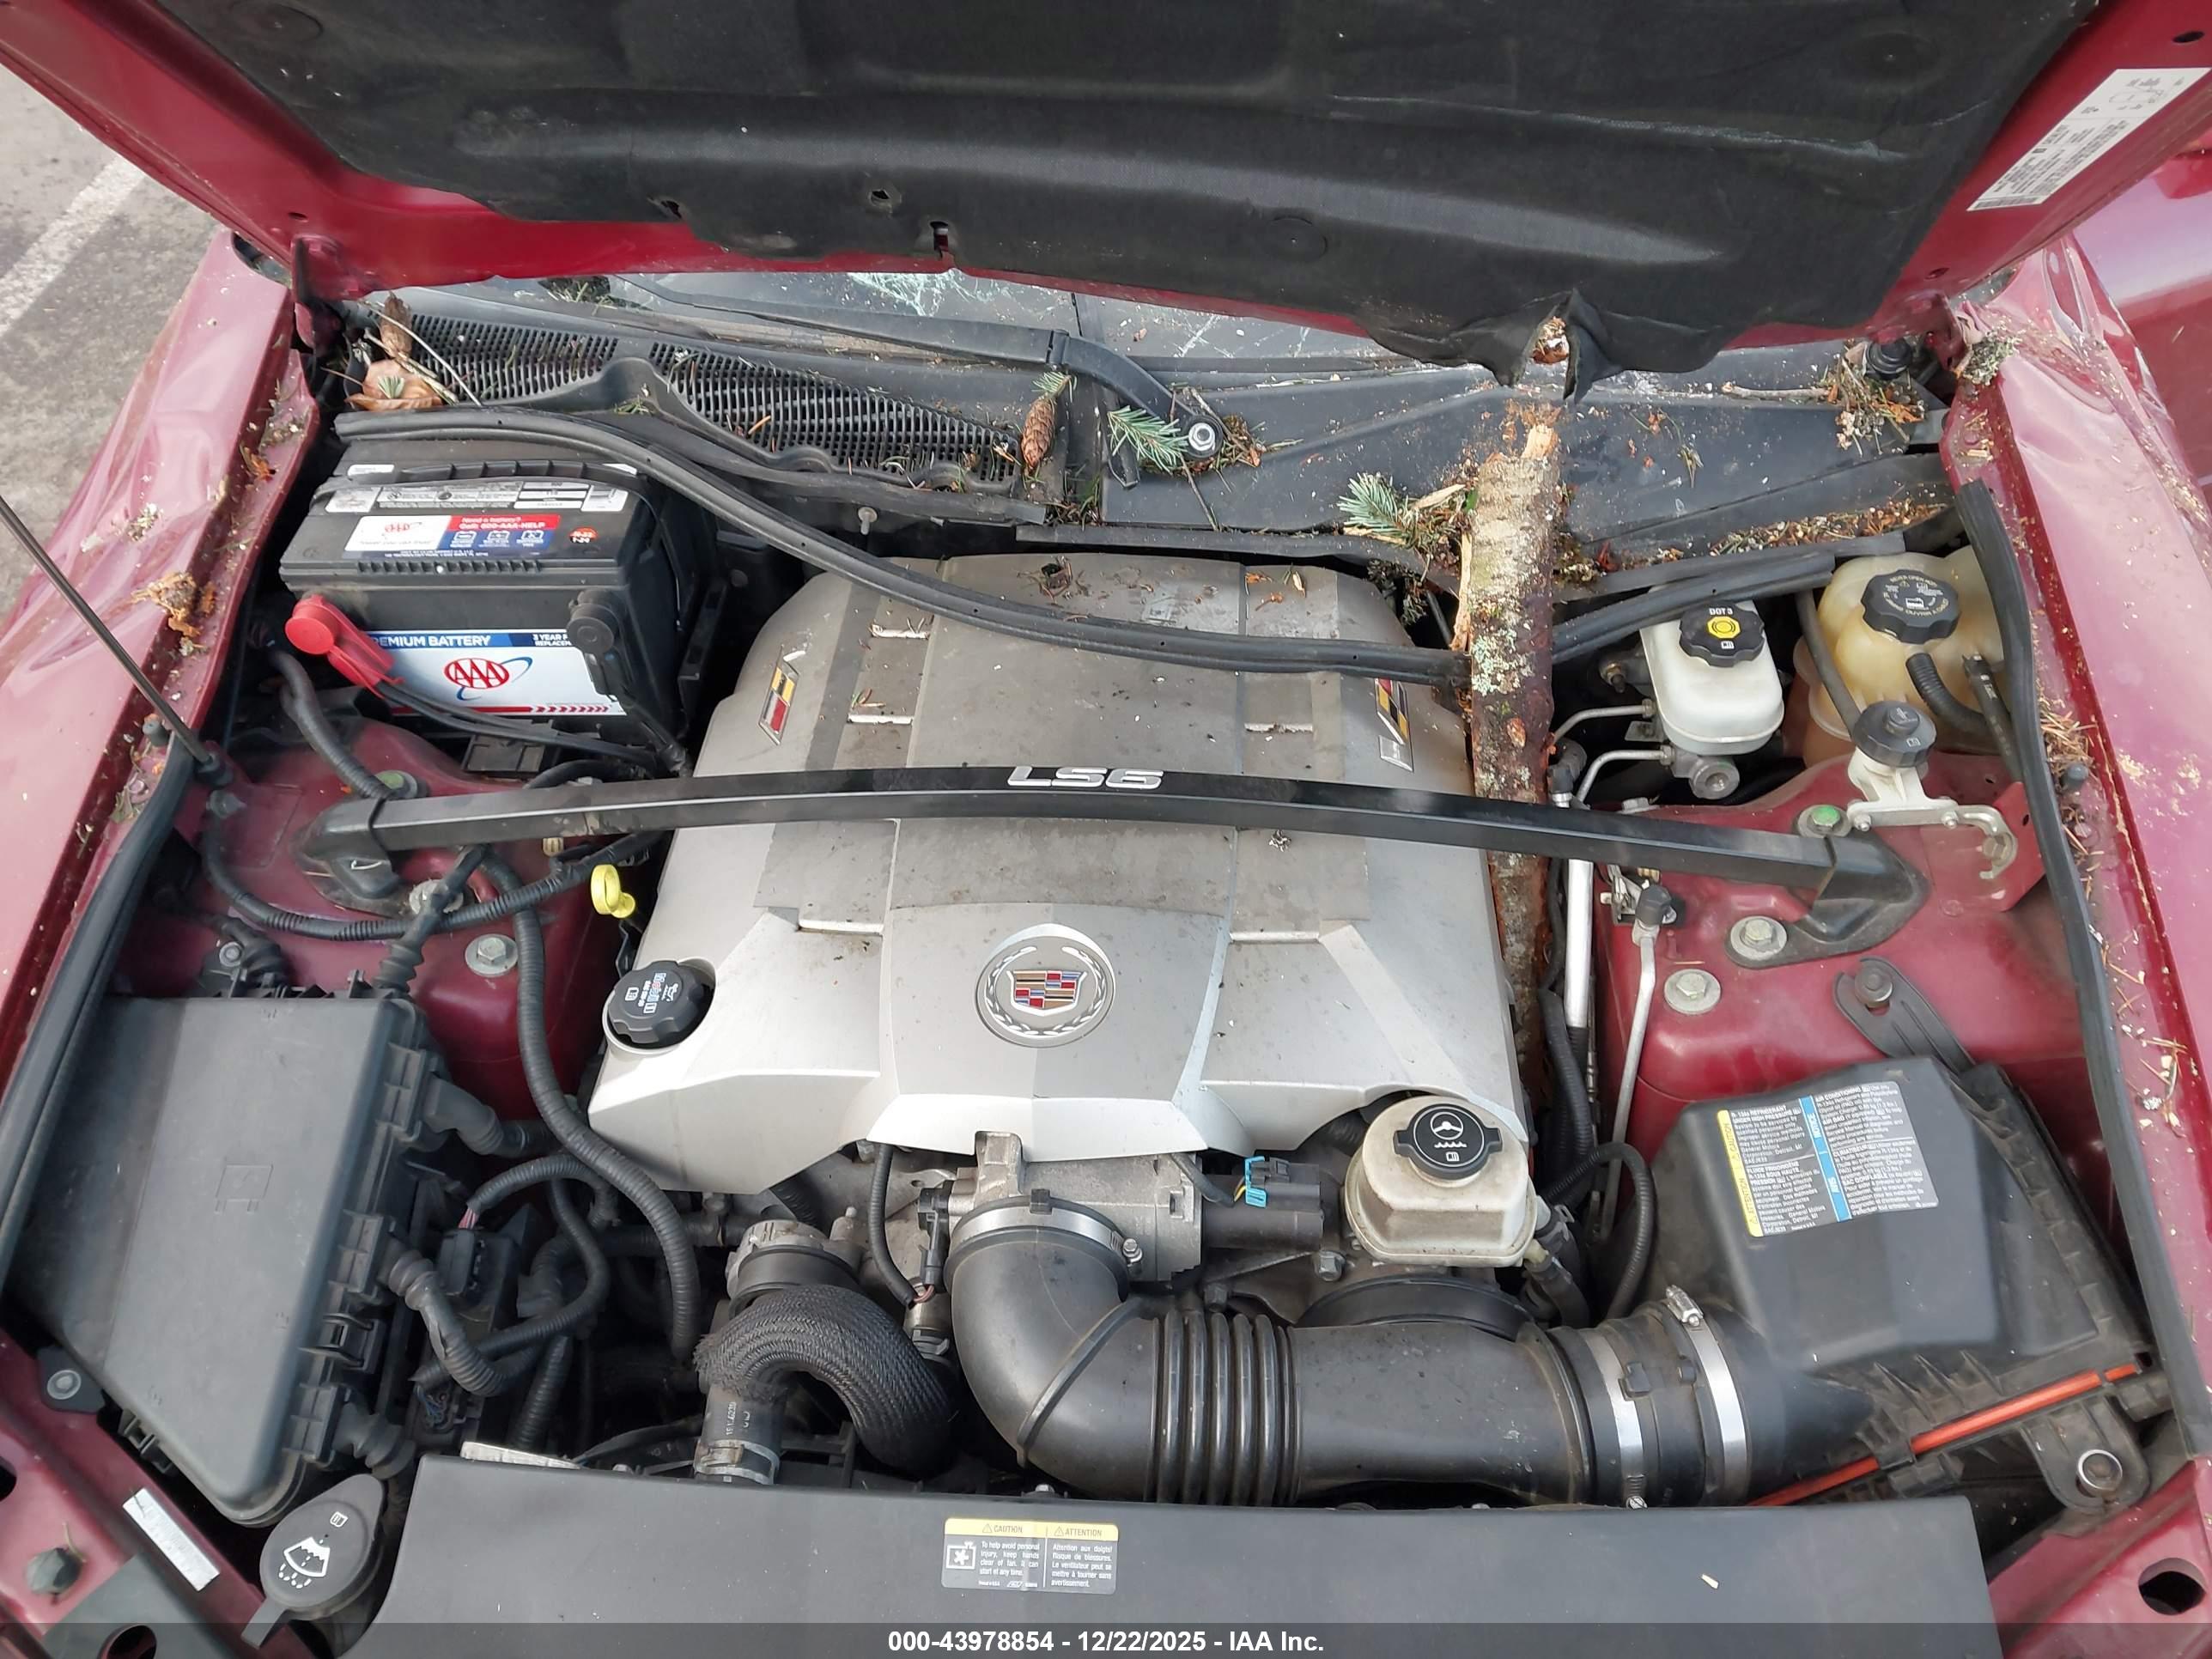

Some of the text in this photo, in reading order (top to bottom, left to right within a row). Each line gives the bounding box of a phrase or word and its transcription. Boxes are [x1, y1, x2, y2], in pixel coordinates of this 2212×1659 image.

[428, 636, 491, 646] BATTERY
[449, 660, 505, 689] AAA
[1007, 766, 1164, 789] LS6
[994, 1525, 1023, 1534] CAUTION
